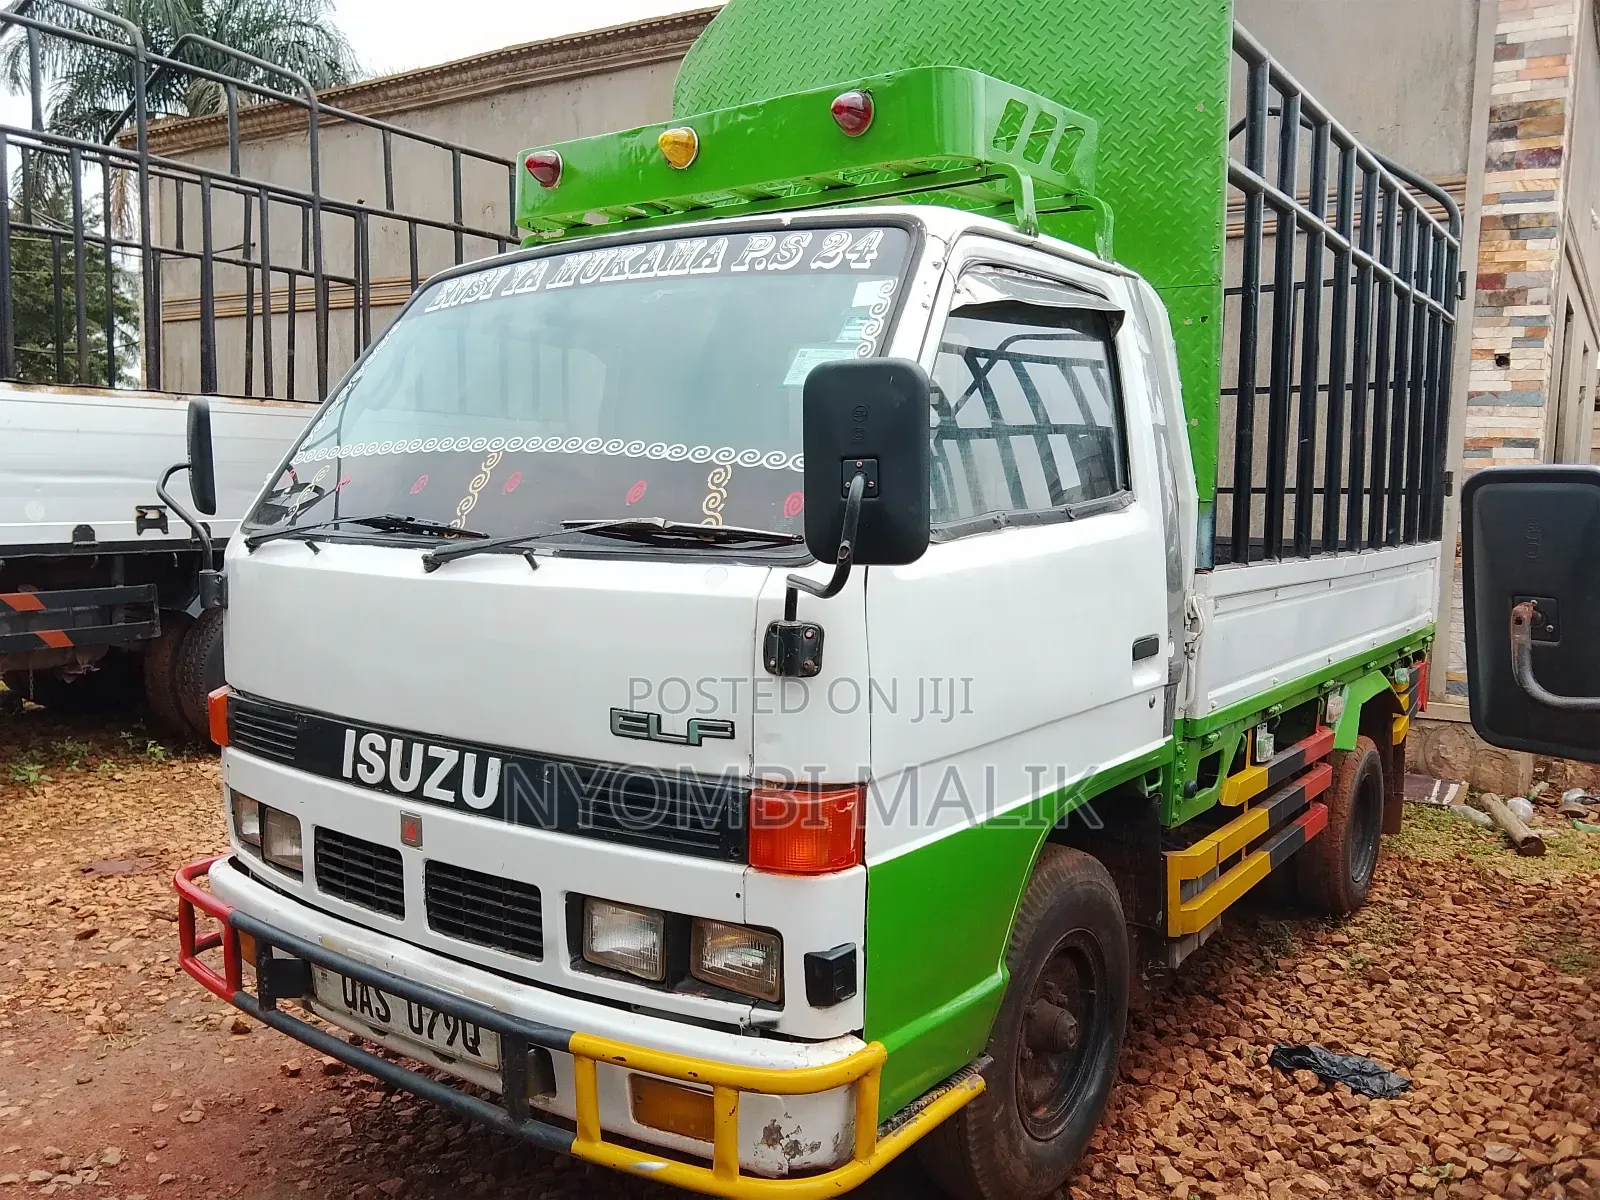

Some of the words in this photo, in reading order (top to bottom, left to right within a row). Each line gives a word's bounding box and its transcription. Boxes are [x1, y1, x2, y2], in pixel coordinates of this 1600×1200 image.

[501, 259, 550, 297] YA
[546, 237, 729, 289] MUKAMA
[731, 230, 814, 273] P.S
[809, 229, 885, 270] 24
[610, 706, 736, 747] ELF
[342, 728, 503, 810] ISUZU
[342, 974, 392, 1024] UAS
